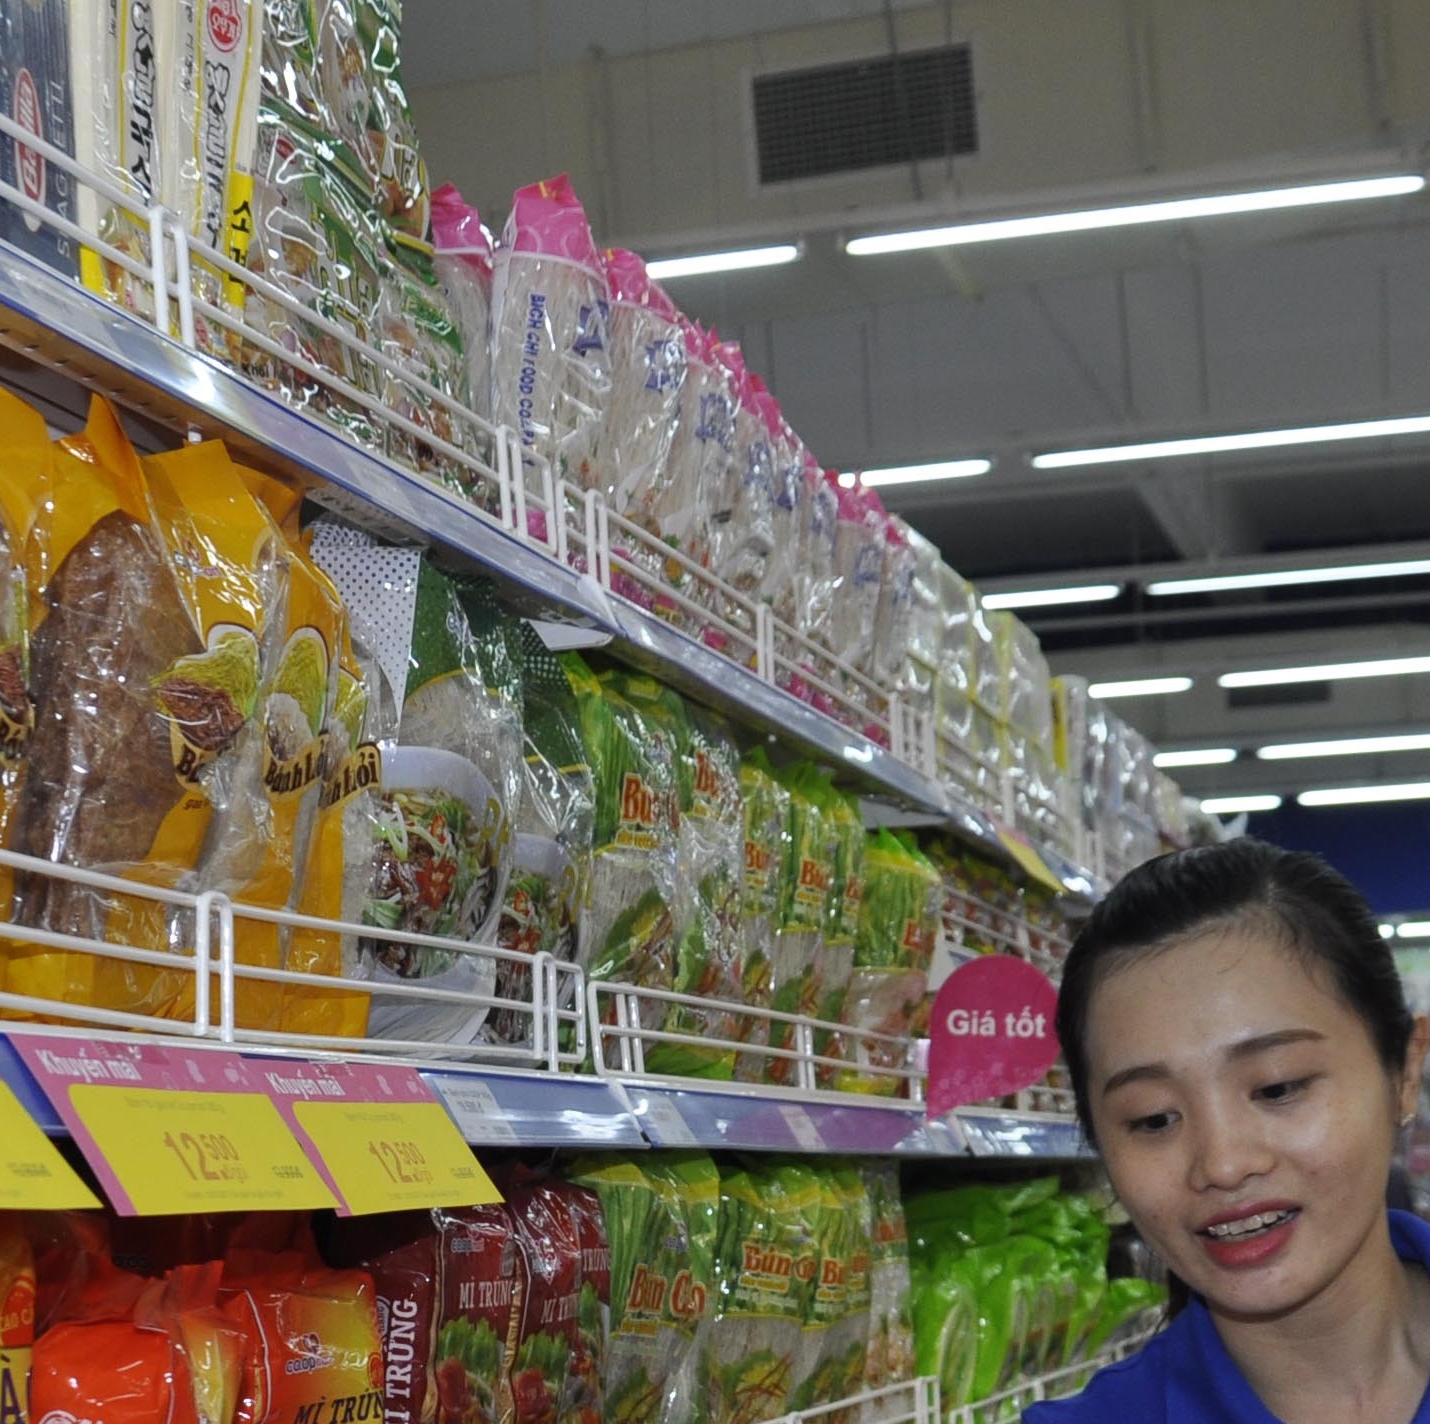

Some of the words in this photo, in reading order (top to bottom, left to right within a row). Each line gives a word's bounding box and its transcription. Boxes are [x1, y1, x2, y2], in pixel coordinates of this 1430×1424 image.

[45, 80, 70, 258] SAGETTI
[946, 1006, 996, 1038] Giá
[1005, 1006, 1047, 1040] tốt
[164, 1131, 219, 1181] 12
[369, 1140, 403, 1184] 12
[383, 1298, 419, 1401] TRỨNG
